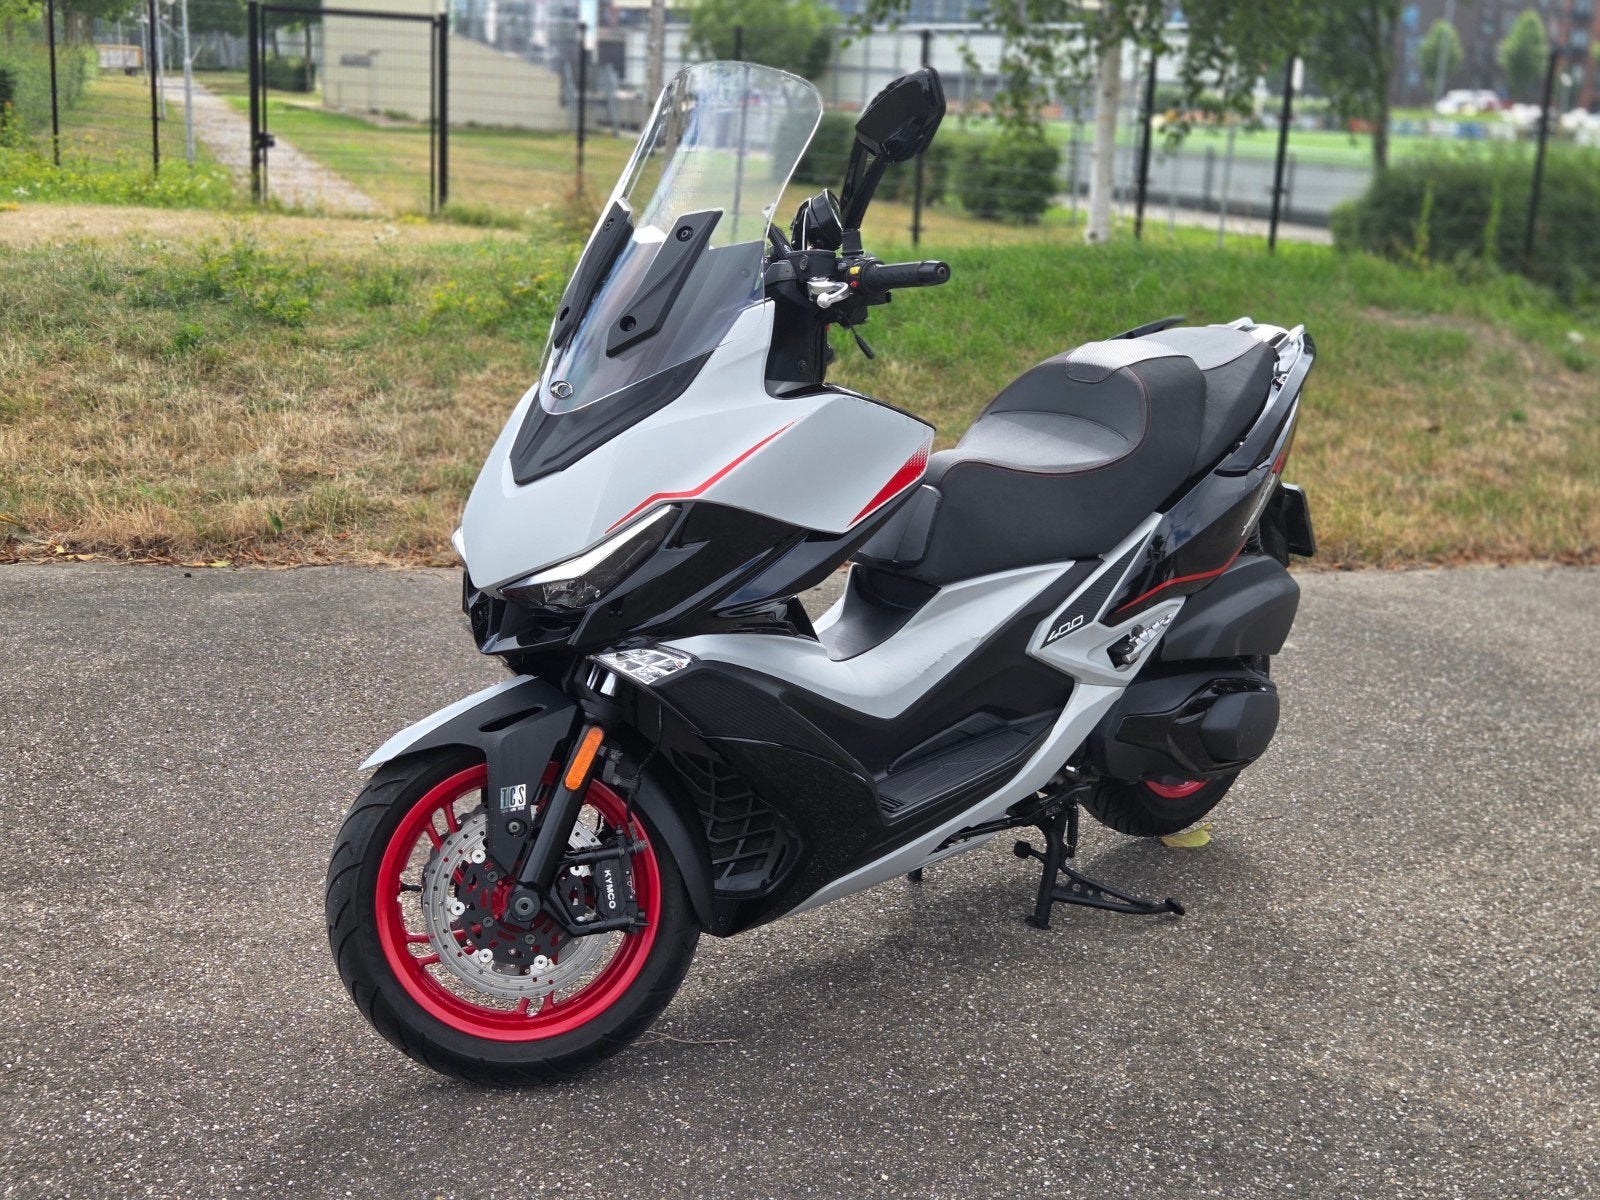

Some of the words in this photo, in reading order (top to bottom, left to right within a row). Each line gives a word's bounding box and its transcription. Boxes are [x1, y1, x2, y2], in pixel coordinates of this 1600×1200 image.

[1047, 615, 1083, 642] 400
[501, 786, 525, 807] TCS
[604, 869, 616, 909] KYMCO
